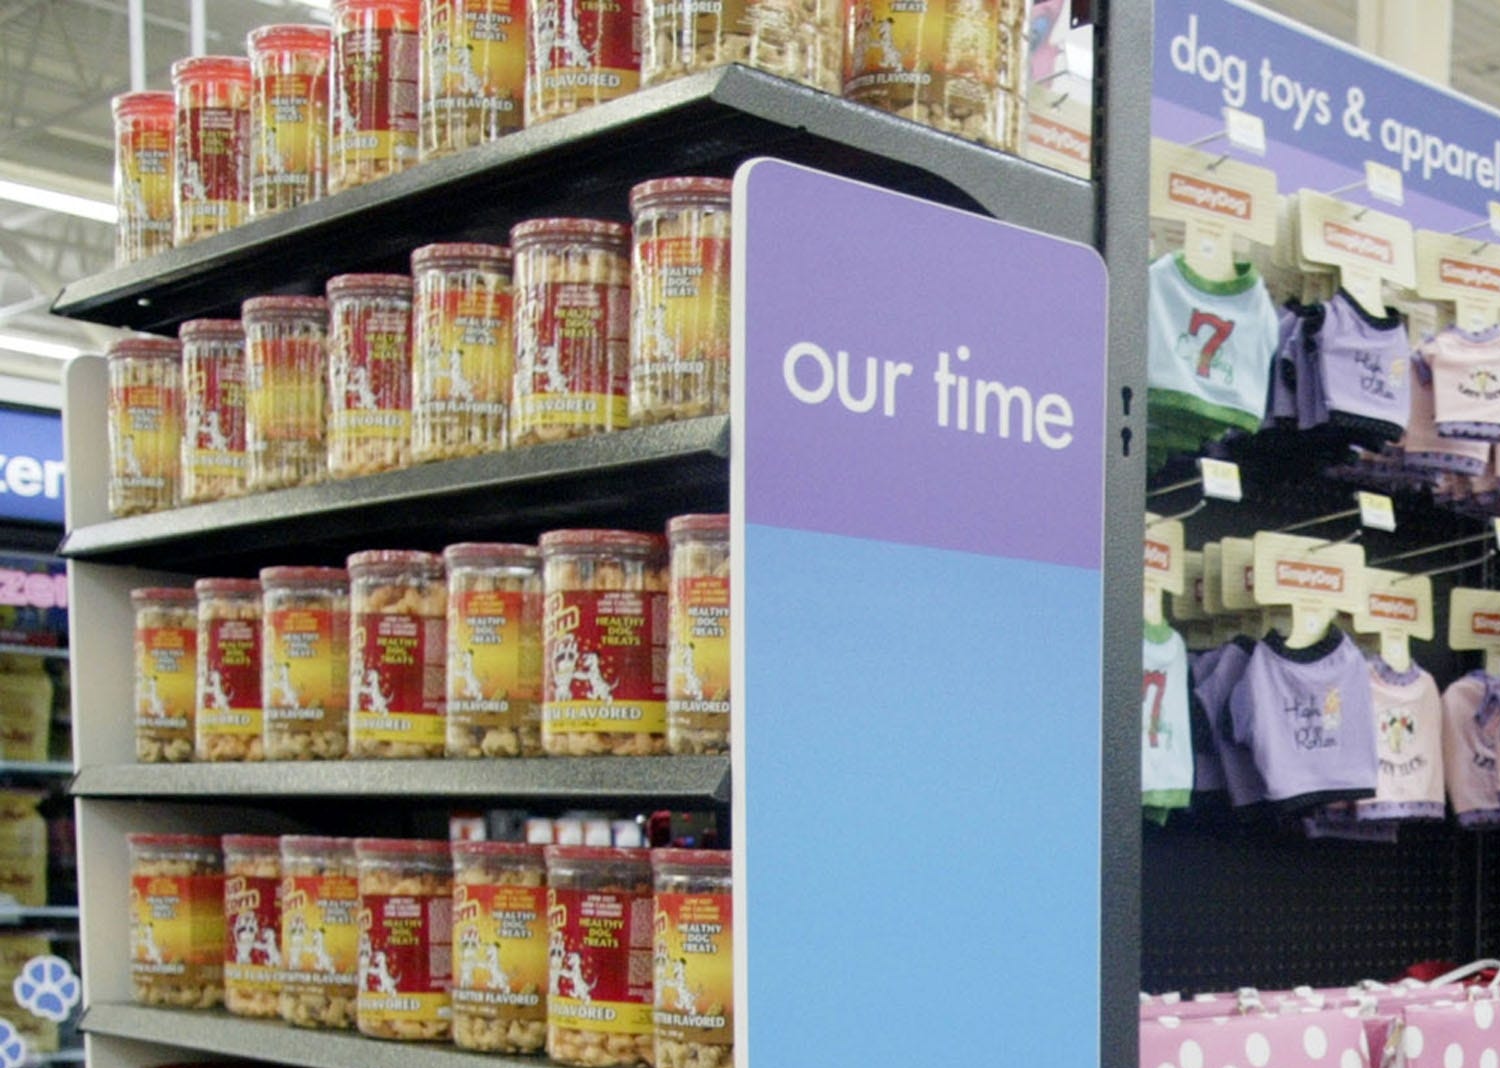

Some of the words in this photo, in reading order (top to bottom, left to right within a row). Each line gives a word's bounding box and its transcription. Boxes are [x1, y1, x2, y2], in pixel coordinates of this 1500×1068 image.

[1170, 14, 1247, 107] dog
[1260, 58, 1331, 131] toys
[1342, 87, 1372, 142] &
[1188, 307, 1235, 379] 7
[783, 341, 914, 417] our
[933, 345, 1075, 450] time
[0, 455, 65, 499] er
[596, 616, 644, 628] HEALTHY
[607, 627, 633, 638] DOG
[601, 636, 640, 647] TREATS
[566, 704, 642, 722] FLAVORED
[579, 917, 624, 929] HEALTHY
[677, 922, 722, 935] HEALTHY
[588, 928, 612, 939] DOG
[687, 933, 711, 944] DOG
[582, 937, 619, 949] TREATS
[681, 942, 717, 954] TREATS
[485, 991, 539, 1005] FLAVORED
[674, 1013, 726, 1029] FLAVORED
